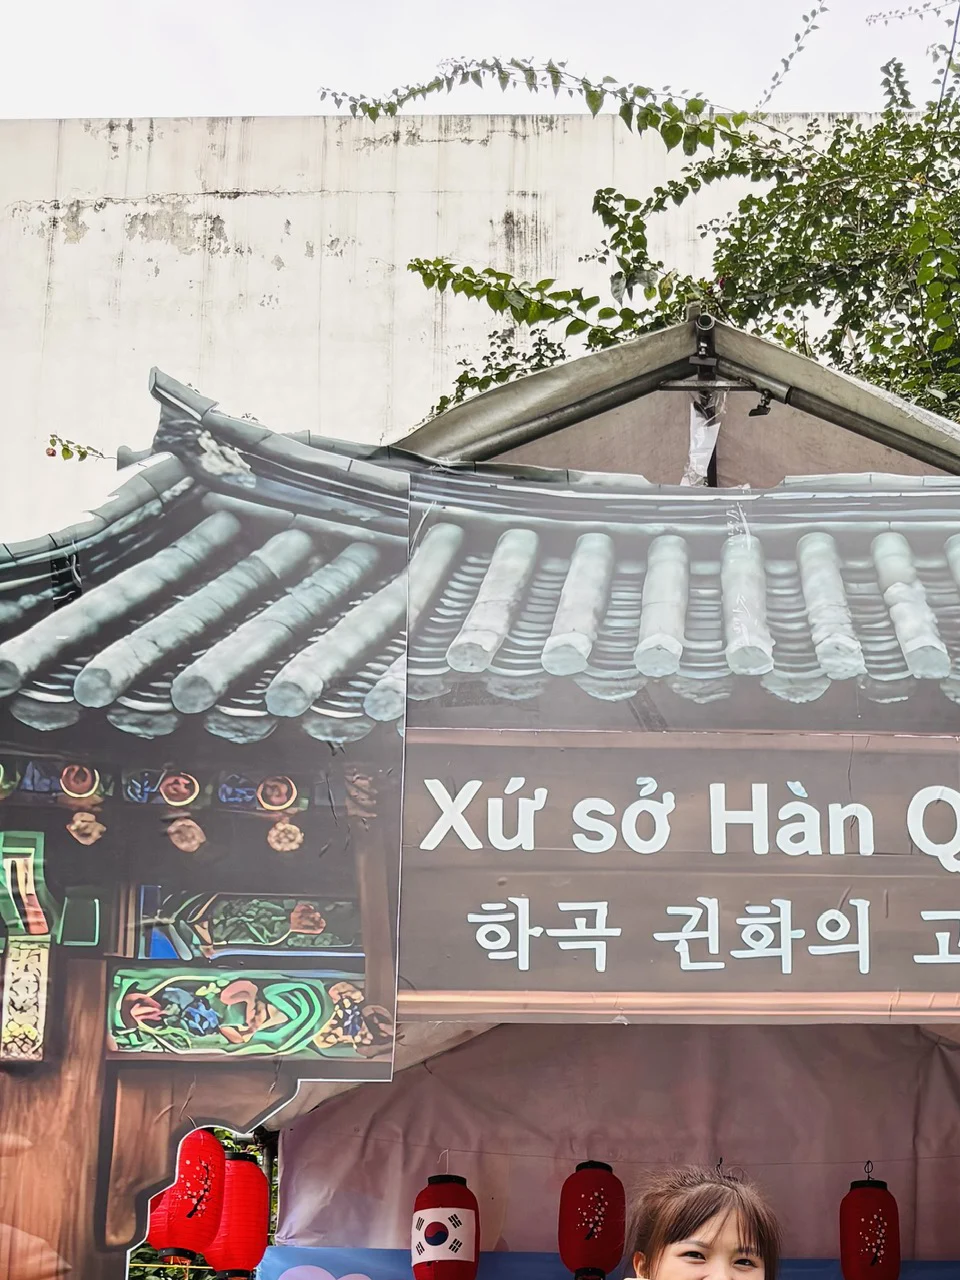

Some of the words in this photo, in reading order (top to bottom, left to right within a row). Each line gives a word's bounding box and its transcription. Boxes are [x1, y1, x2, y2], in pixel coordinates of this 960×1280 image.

[419, 776, 548, 851] Xứ
[572, 776, 676, 854] sở
[709, 780, 875, 856] Hàn
